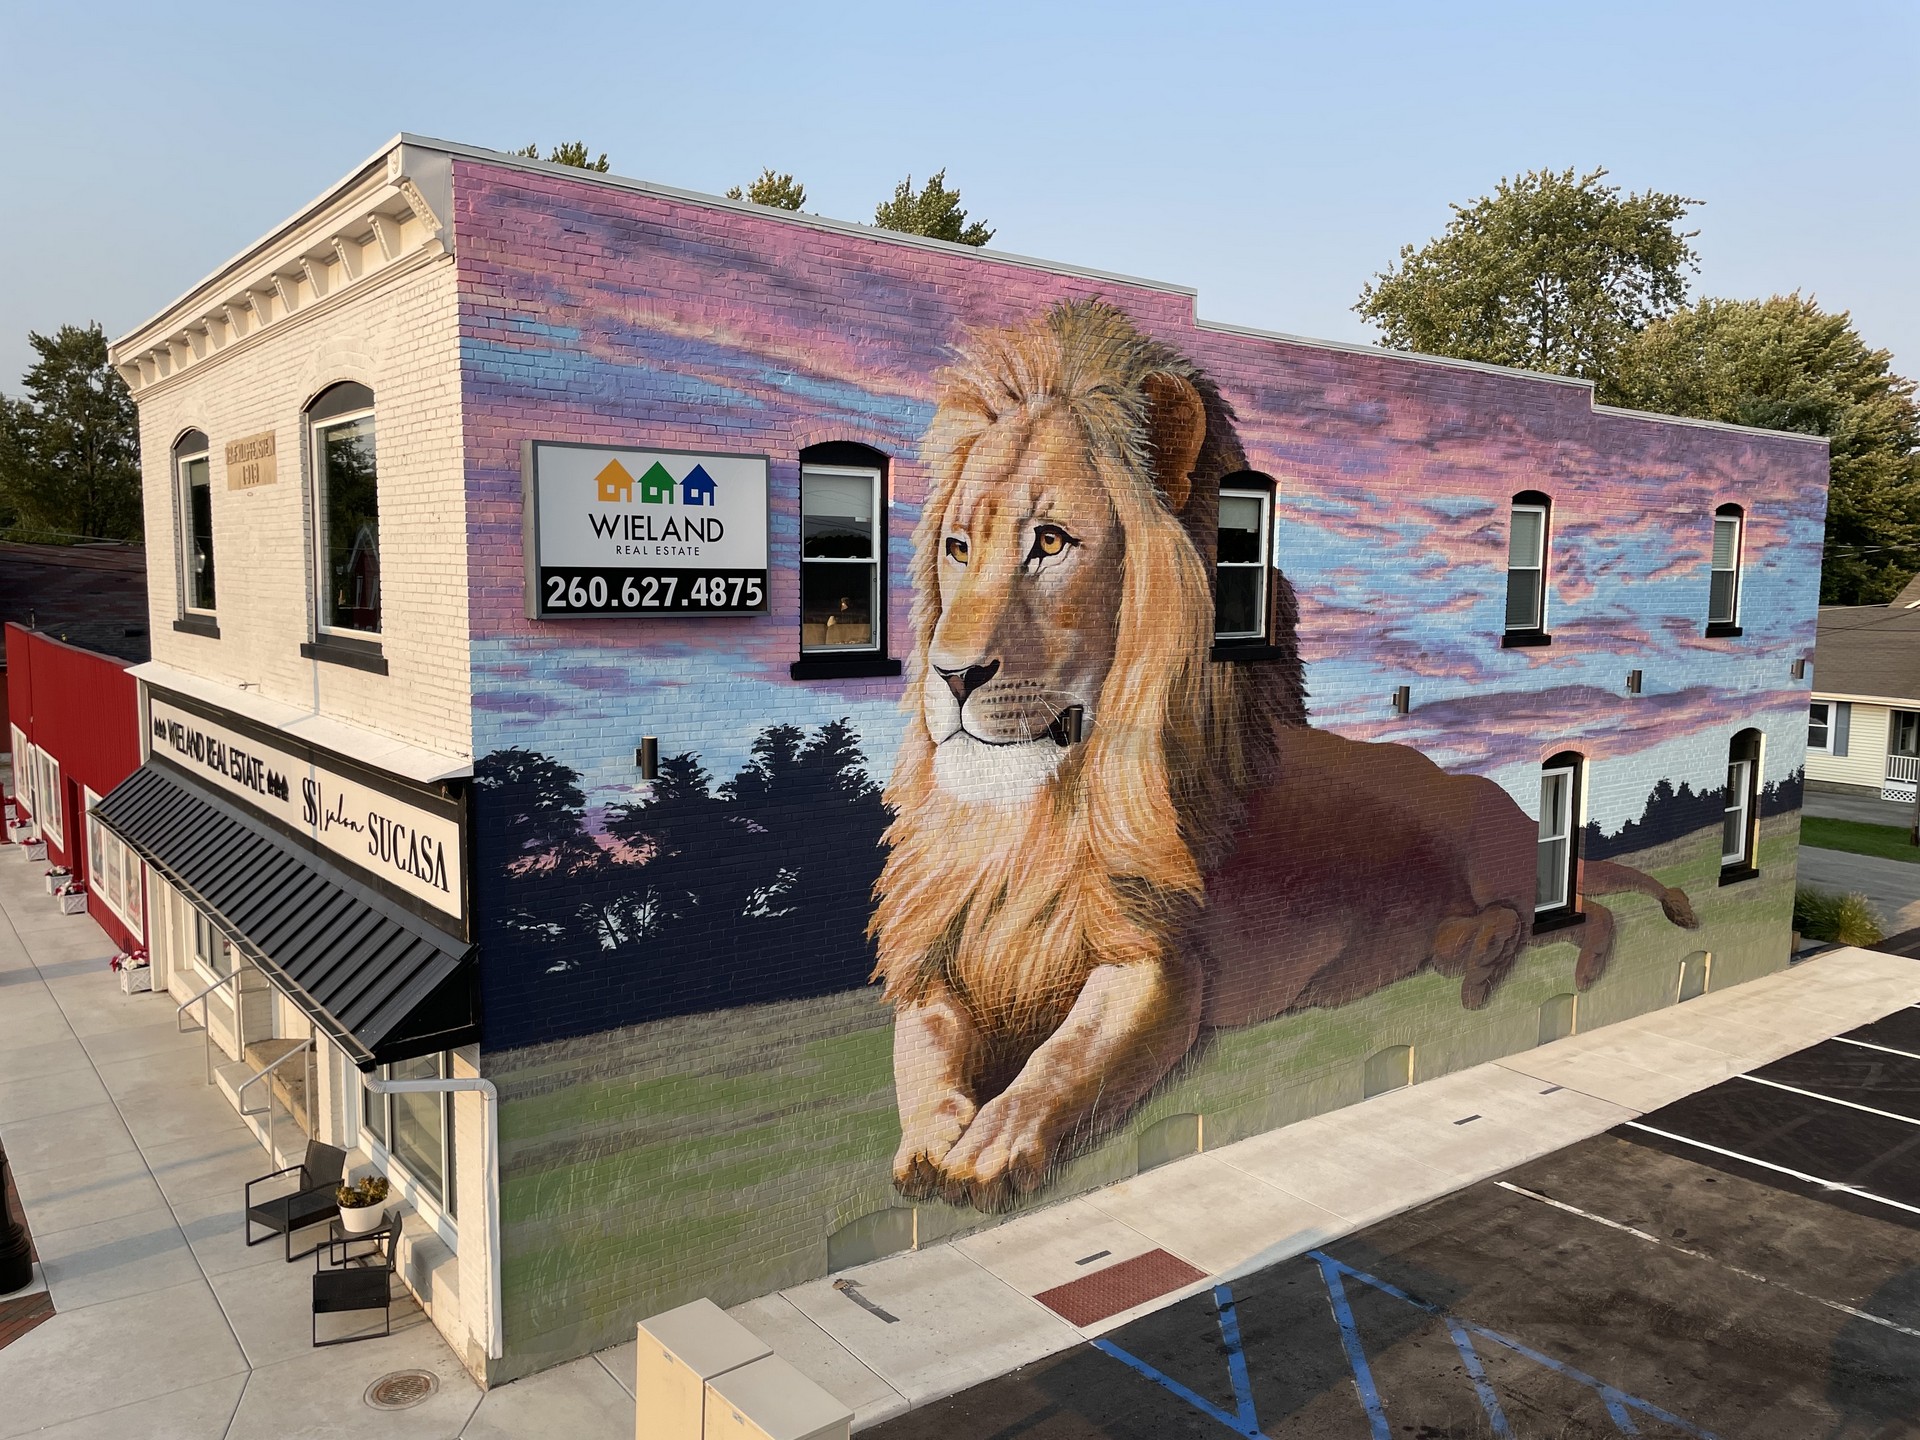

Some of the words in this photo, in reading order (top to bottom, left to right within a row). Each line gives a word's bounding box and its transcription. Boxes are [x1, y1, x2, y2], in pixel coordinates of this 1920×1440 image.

[588, 513, 724, 543] WIELAND
[616, 545, 648, 556] REAL
[656, 546, 700, 556] ESTATE
[546, 575, 763, 608] 260.627.4875
[167, 718, 205, 763] WIELAND
[206, 735, 229, 777] REAL
[229, 746, 266, 796] ESTATE
[368, 811, 451, 893] SUCASA
